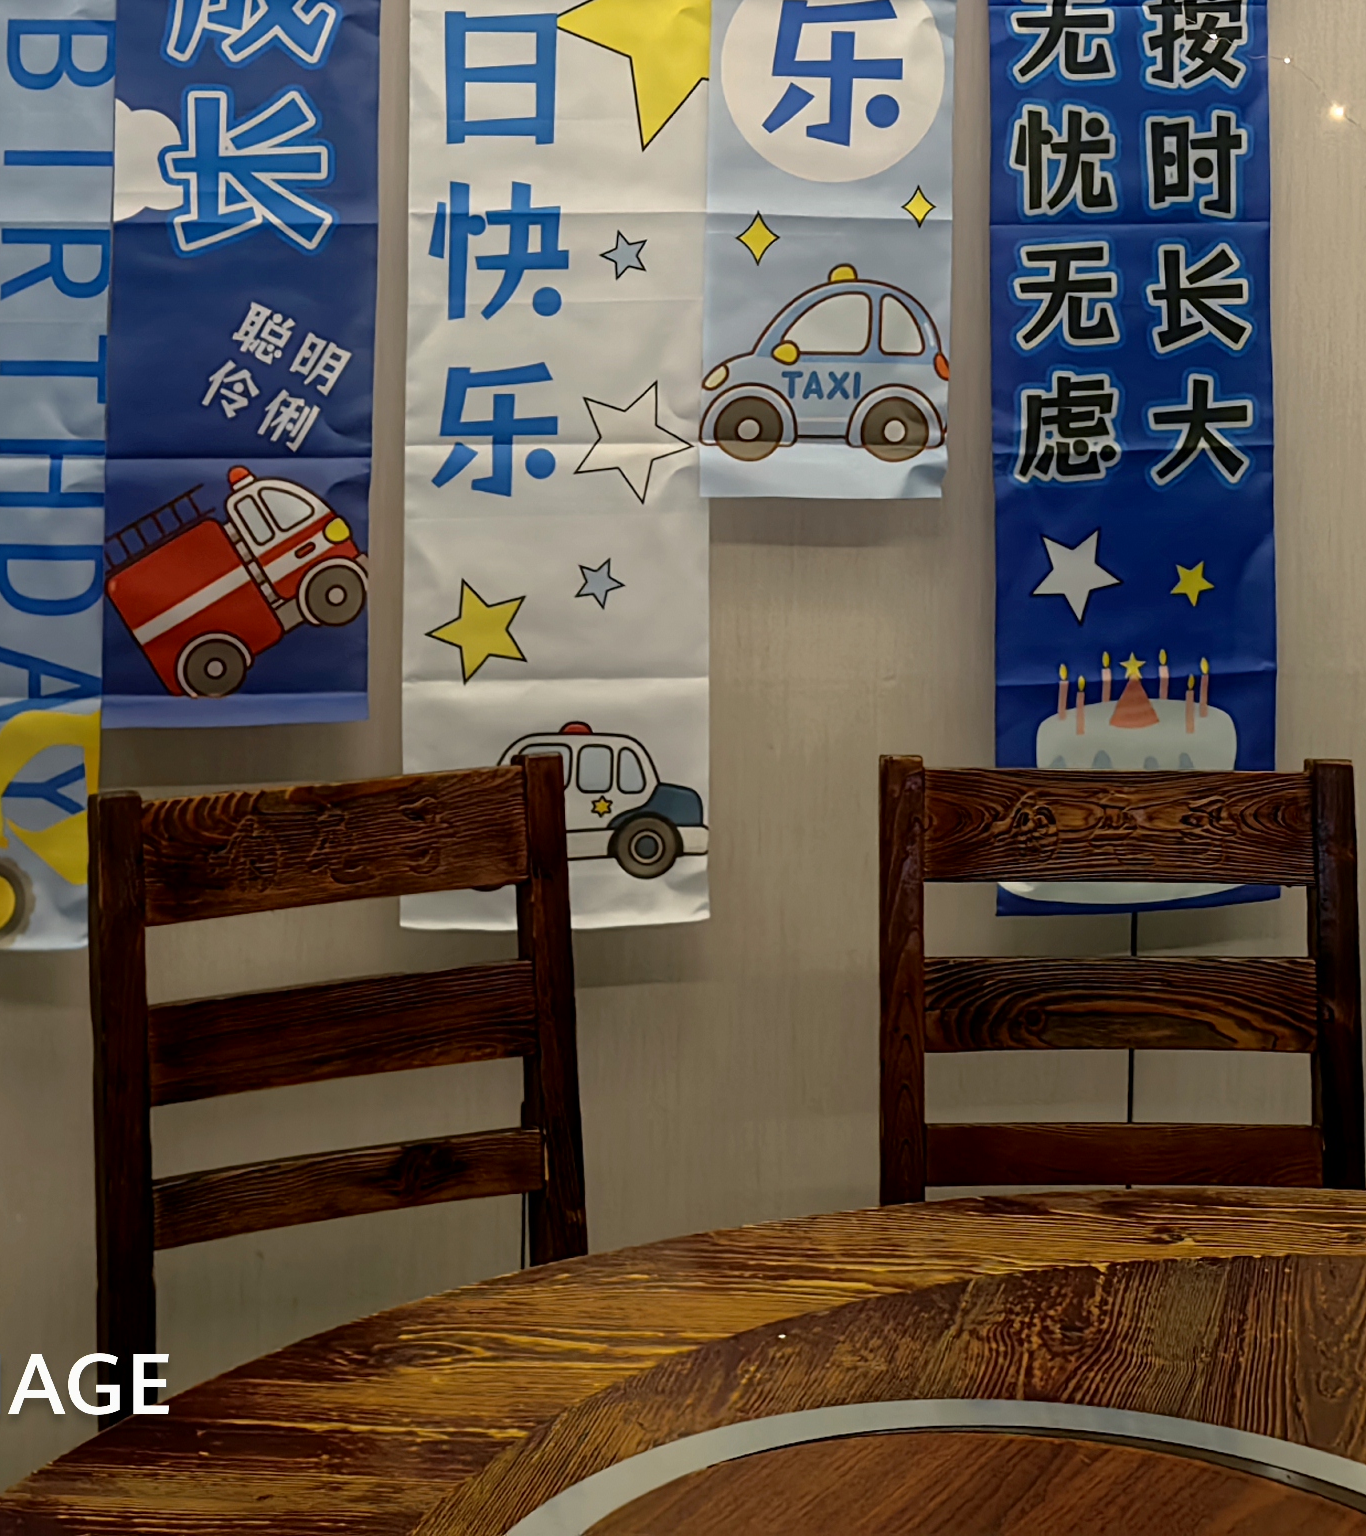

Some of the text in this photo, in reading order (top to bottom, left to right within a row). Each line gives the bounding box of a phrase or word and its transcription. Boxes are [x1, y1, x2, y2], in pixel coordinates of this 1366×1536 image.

[232, 301, 352, 396] 聪明
[781, 370, 863, 402] TAXI
[201, 360, 321, 452] 伶俐
